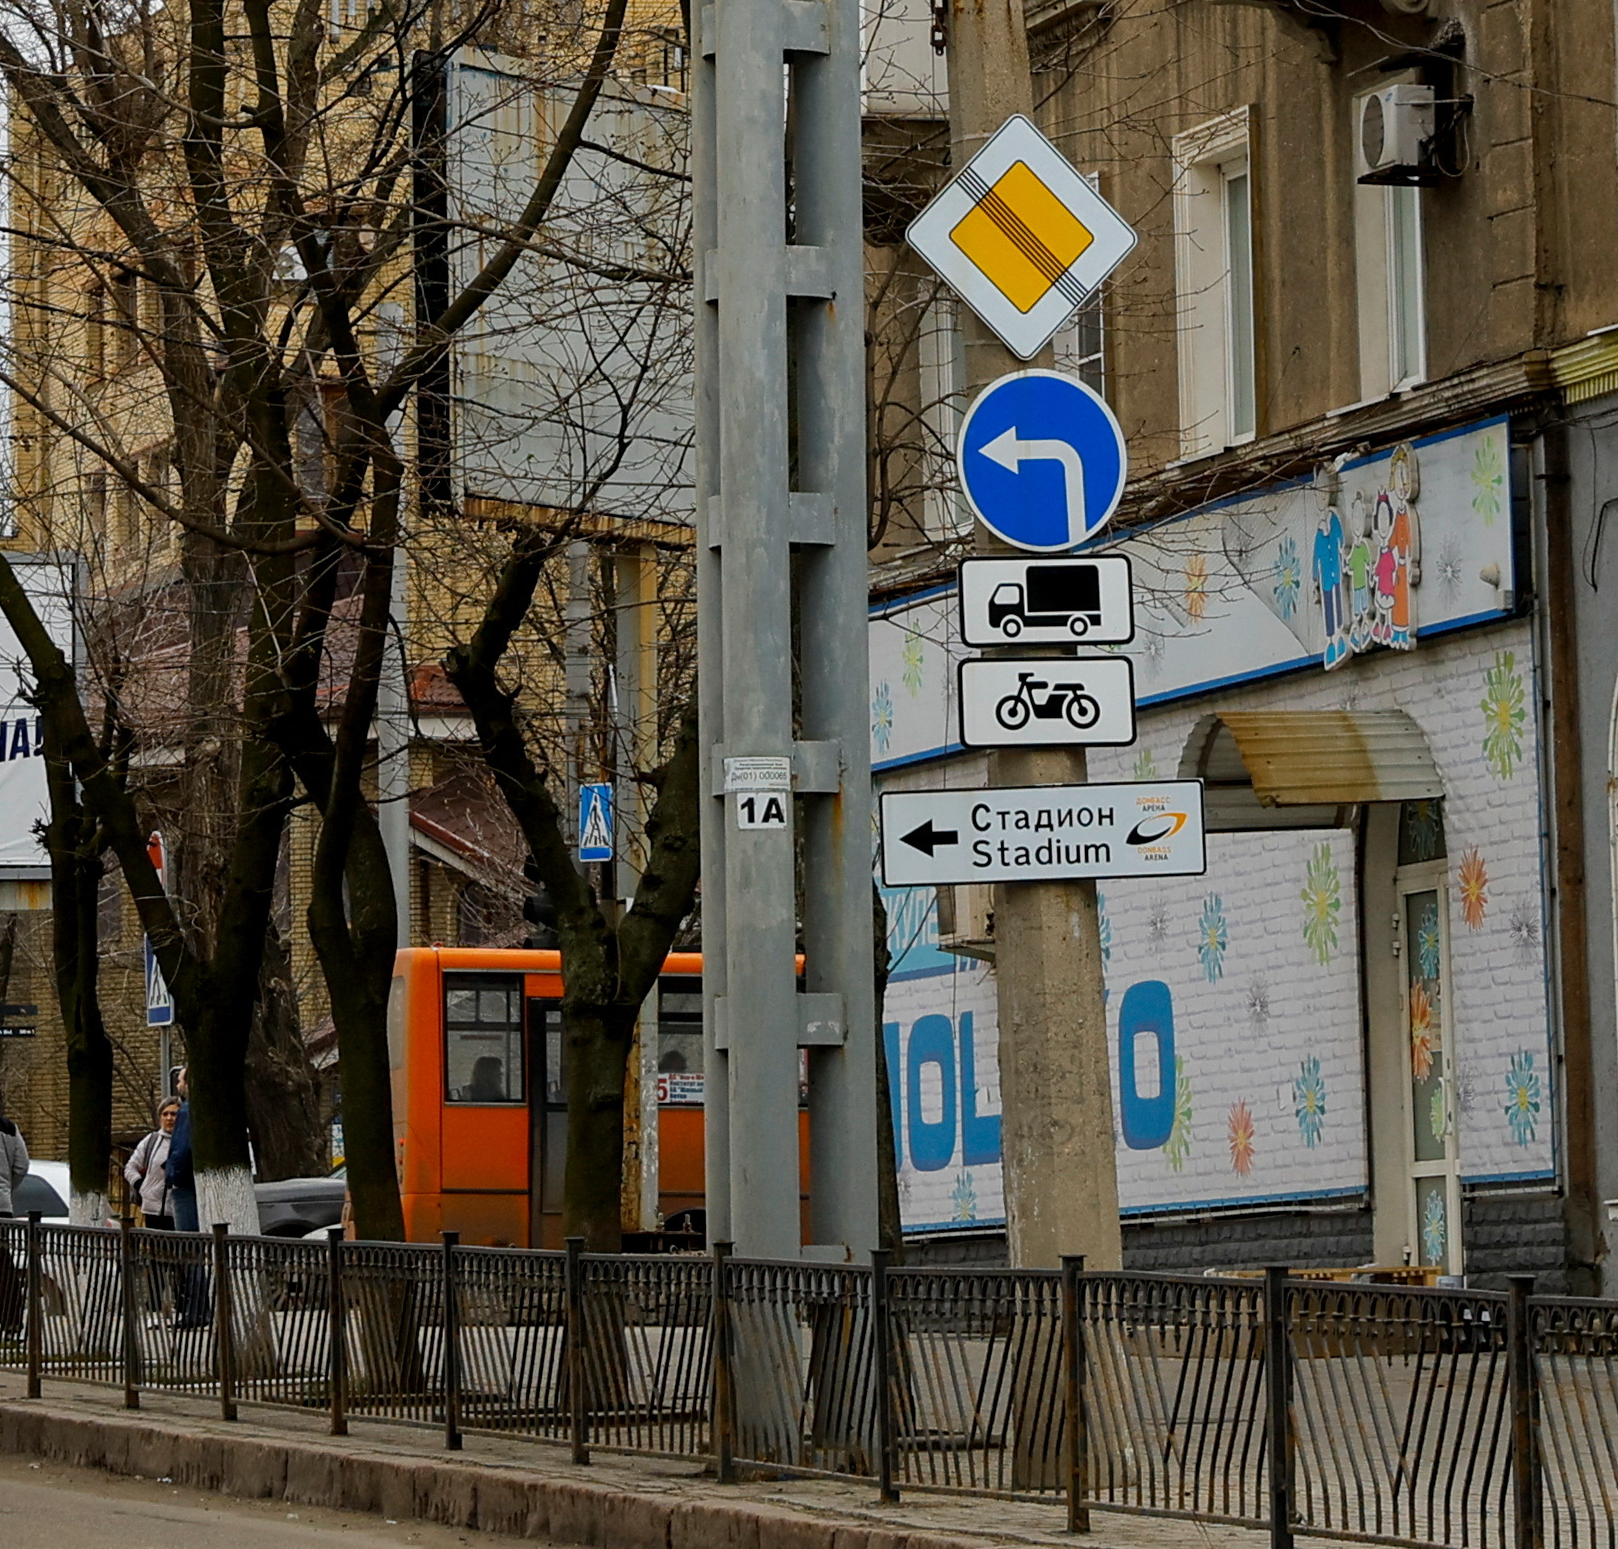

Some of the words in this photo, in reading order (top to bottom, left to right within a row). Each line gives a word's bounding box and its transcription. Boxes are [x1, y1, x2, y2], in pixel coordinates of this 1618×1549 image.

[741, 796, 785, 823] 1А
[1136, 796, 1170, 805] ДОНБАСС
[970, 802, 1116, 833] Стадион
[971, 840, 1111, 868] Stadium
[1137, 846, 1171, 854] DONBASS
